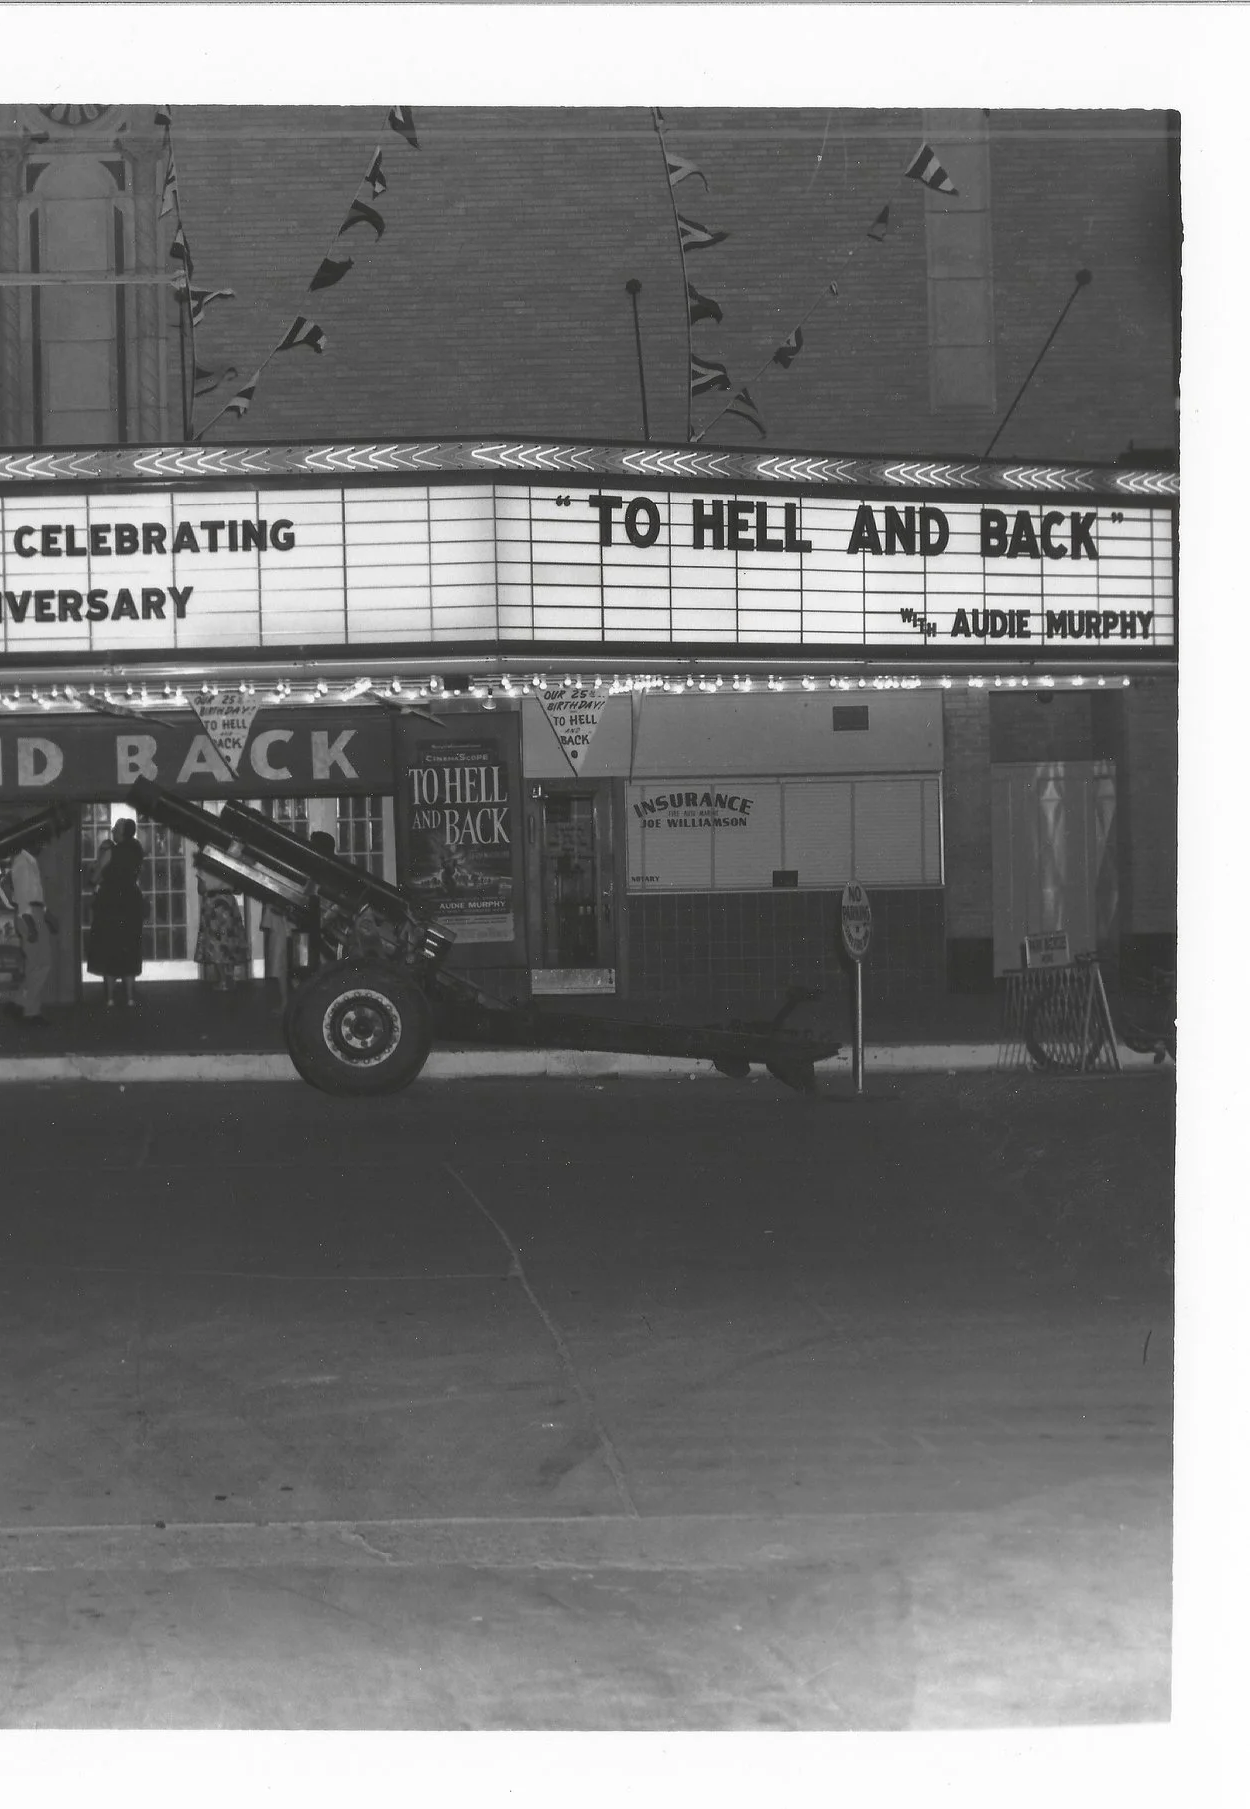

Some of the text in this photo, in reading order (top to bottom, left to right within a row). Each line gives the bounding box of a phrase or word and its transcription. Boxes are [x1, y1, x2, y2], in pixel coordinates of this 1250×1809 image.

[692, 499, 812, 553] HELL
[847, 505, 949, 556] AND
[12, 519, 296, 558] CELEBRATING
[900, 608, 1154, 639] WITH AUDIE MURPHY
[544, 690, 566, 700] OUR
[222, 719, 248, 730] HELL
[553, 714, 597, 726] TO HELL
[560, 734, 590, 745] BACK
[116, 730, 360, 785] BACK
[408, 766, 508, 805] TO HELL
[633, 792, 754, 818] INSURANCE
[411, 807, 510, 845] AND BACK
[640, 817, 747, 828] JOE WILLIAMSON
[468, 900, 506, 909] MURPHY
[848, 886, 862, 902] NO
